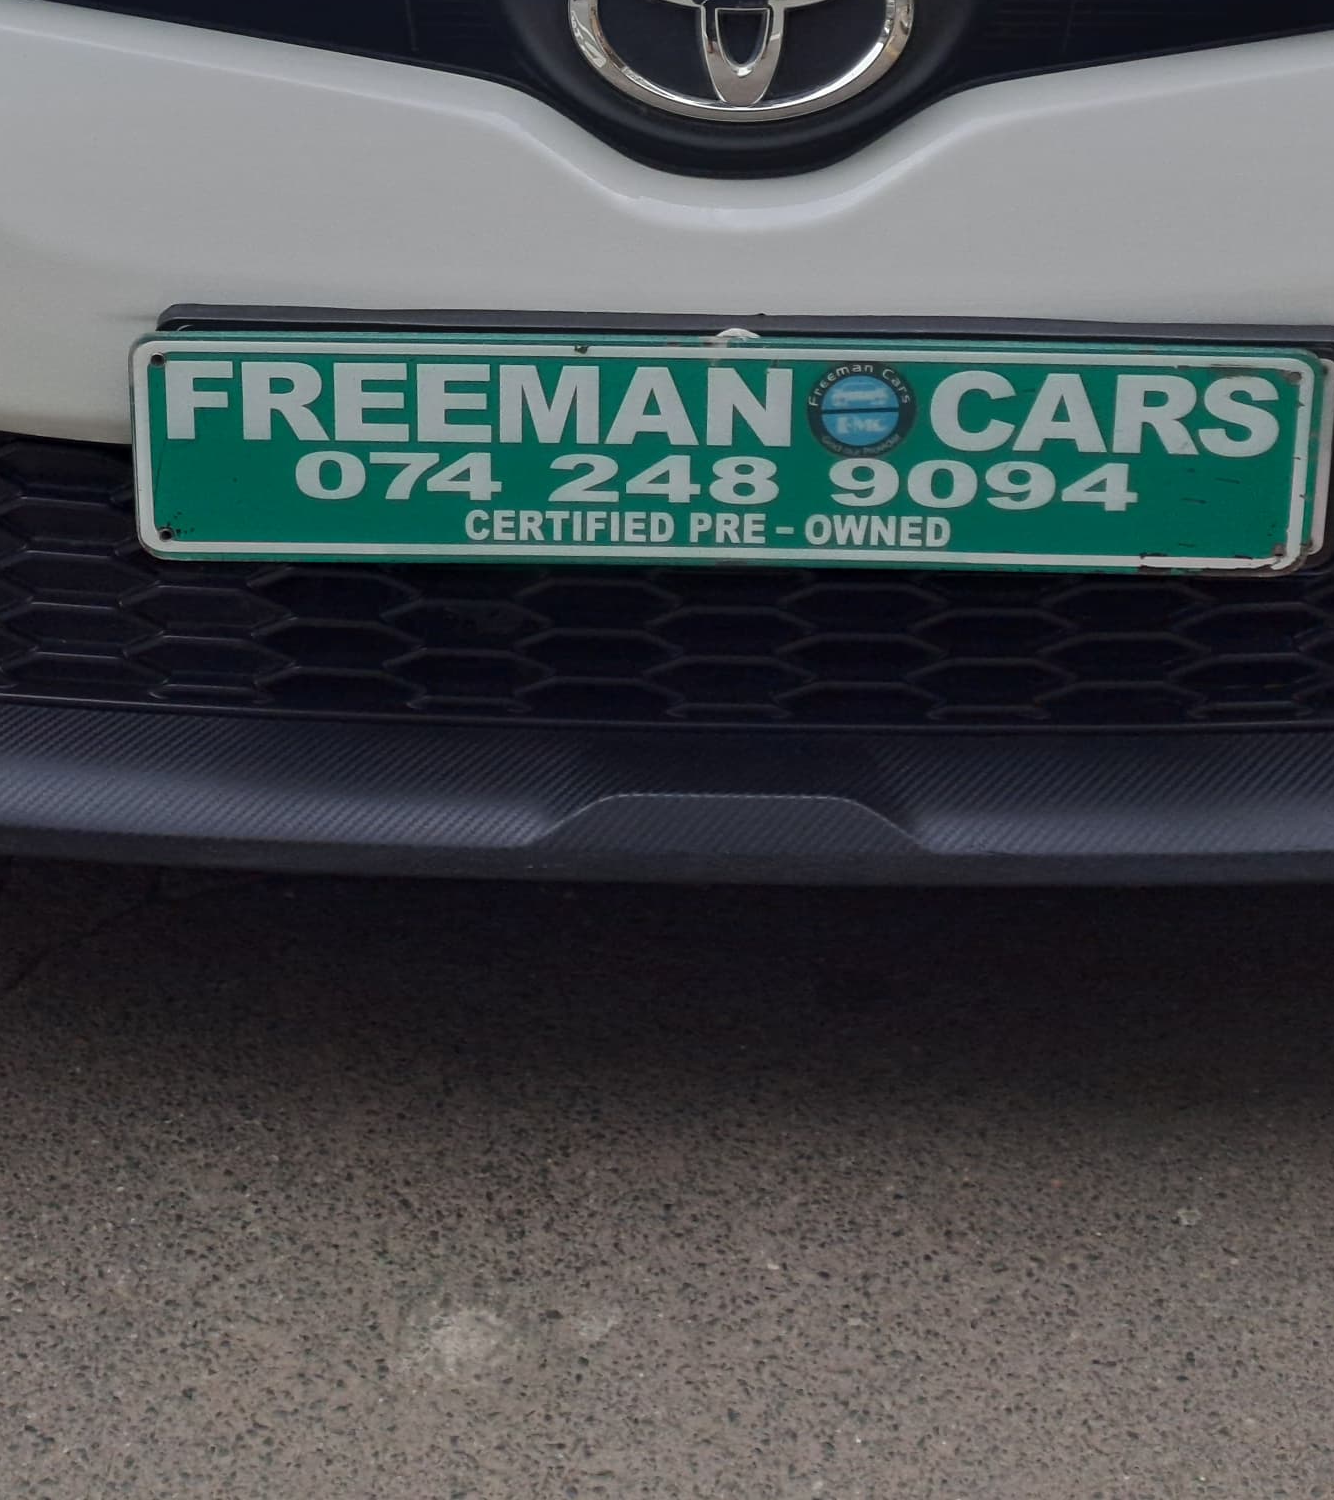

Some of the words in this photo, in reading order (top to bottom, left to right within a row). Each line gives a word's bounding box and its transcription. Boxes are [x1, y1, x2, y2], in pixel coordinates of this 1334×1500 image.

[164, 360, 793, 447] FREEMAN
[929, 370, 1280, 455] CARS
[808, 365, 874, 407] Freeman
[882, 369, 911, 404] Cars
[294, 451, 503, 501] 074
[548, 453, 779, 505] 248
[829, 457, 1138, 511] 9094
[464, 509, 675, 543] CERTIFIED
[689, 512, 767, 545] PRE
[804, 514, 952, 548] OWNED
